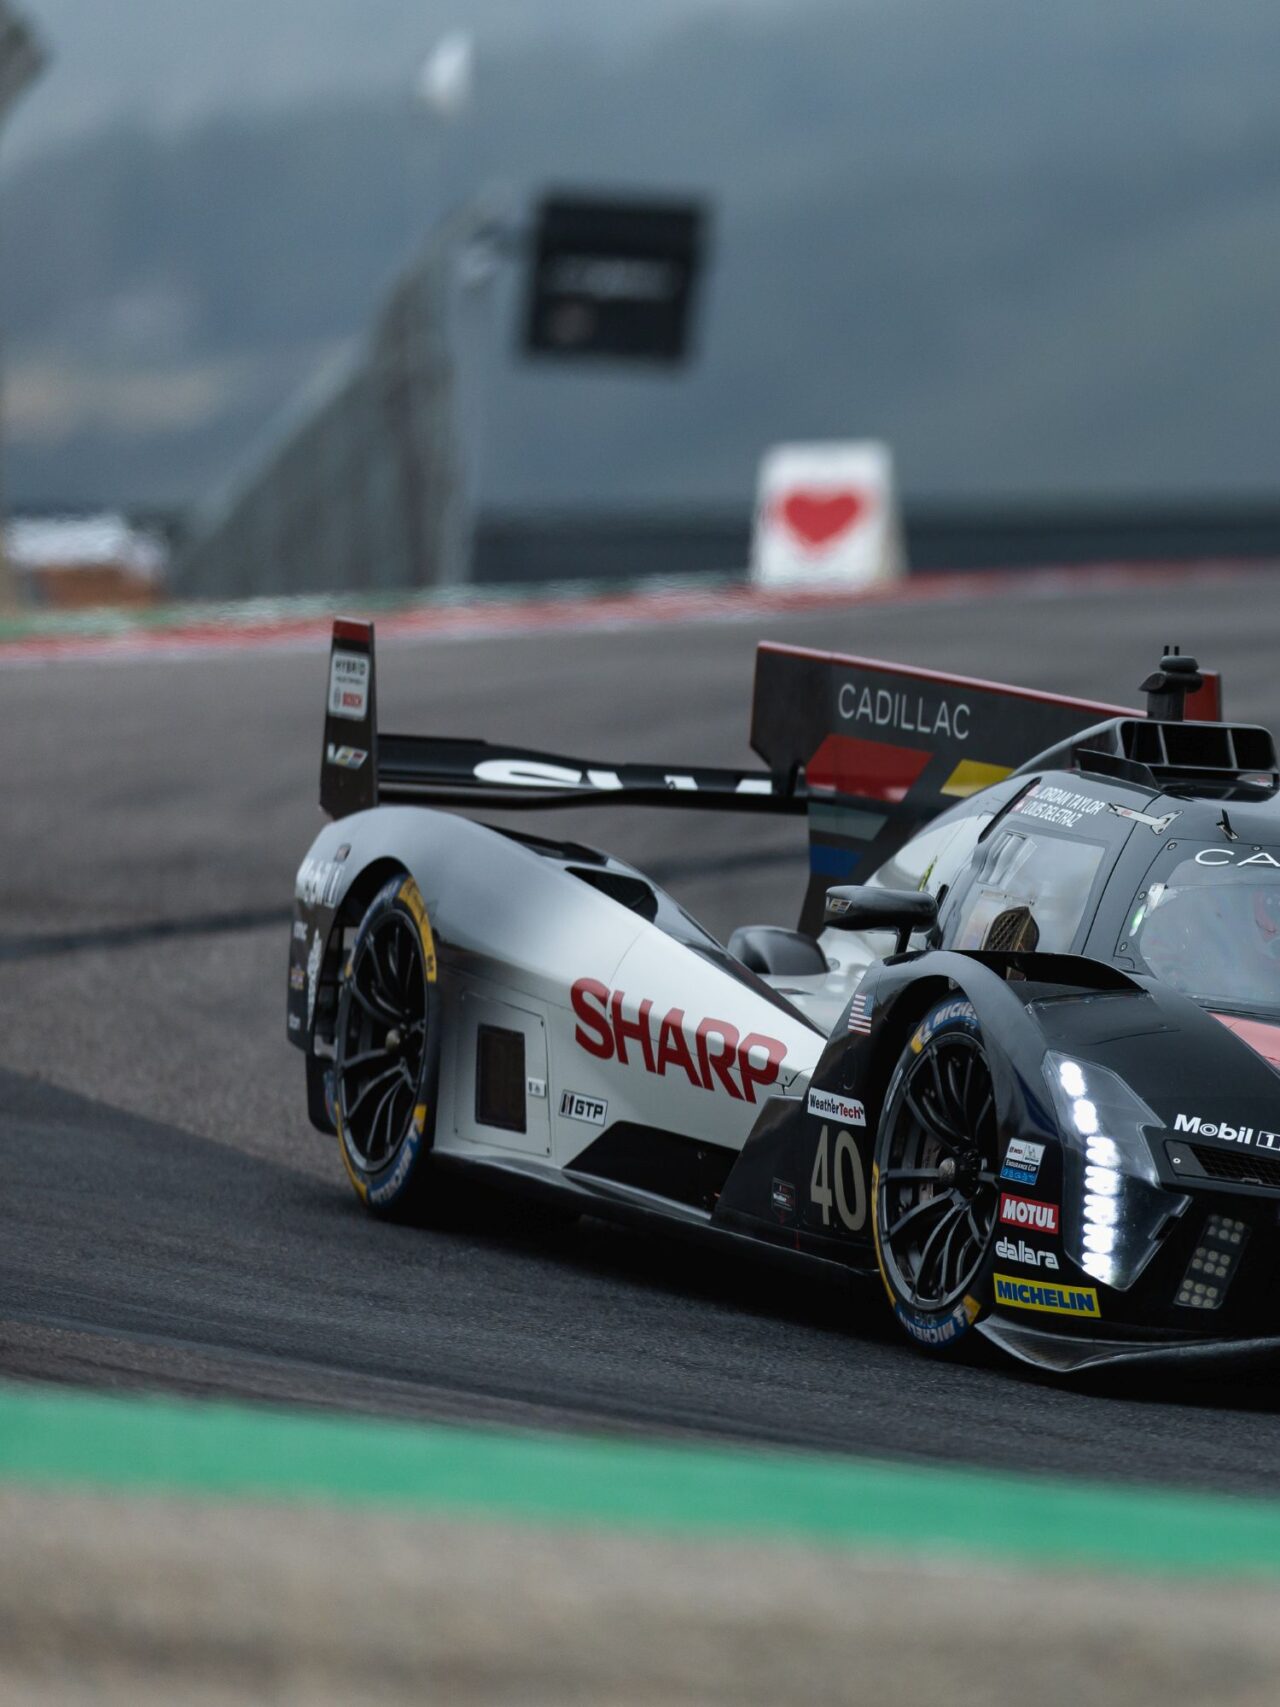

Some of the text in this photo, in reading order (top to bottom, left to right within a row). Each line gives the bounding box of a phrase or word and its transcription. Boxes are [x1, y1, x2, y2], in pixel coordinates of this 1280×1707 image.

[838, 682, 970, 740] CADILLAC
[1021, 800, 1083, 827] LOUIS DELETRAZ
[1036, 786, 1105, 815] JORDAN TAYLOR
[570, 977, 788, 1104] SHARP
[575, 1099, 604, 1120] GTP
[810, 1093, 864, 1120] WeatherTech
[1174, 1113, 1254, 1145] Mobil
[810, 1124, 867, 1231] 40
[1002, 1198, 1056, 1229] MOTUL
[995, 1236, 1060, 1270] dallara
[996, 1280, 1096, 1312] MICHELIN
